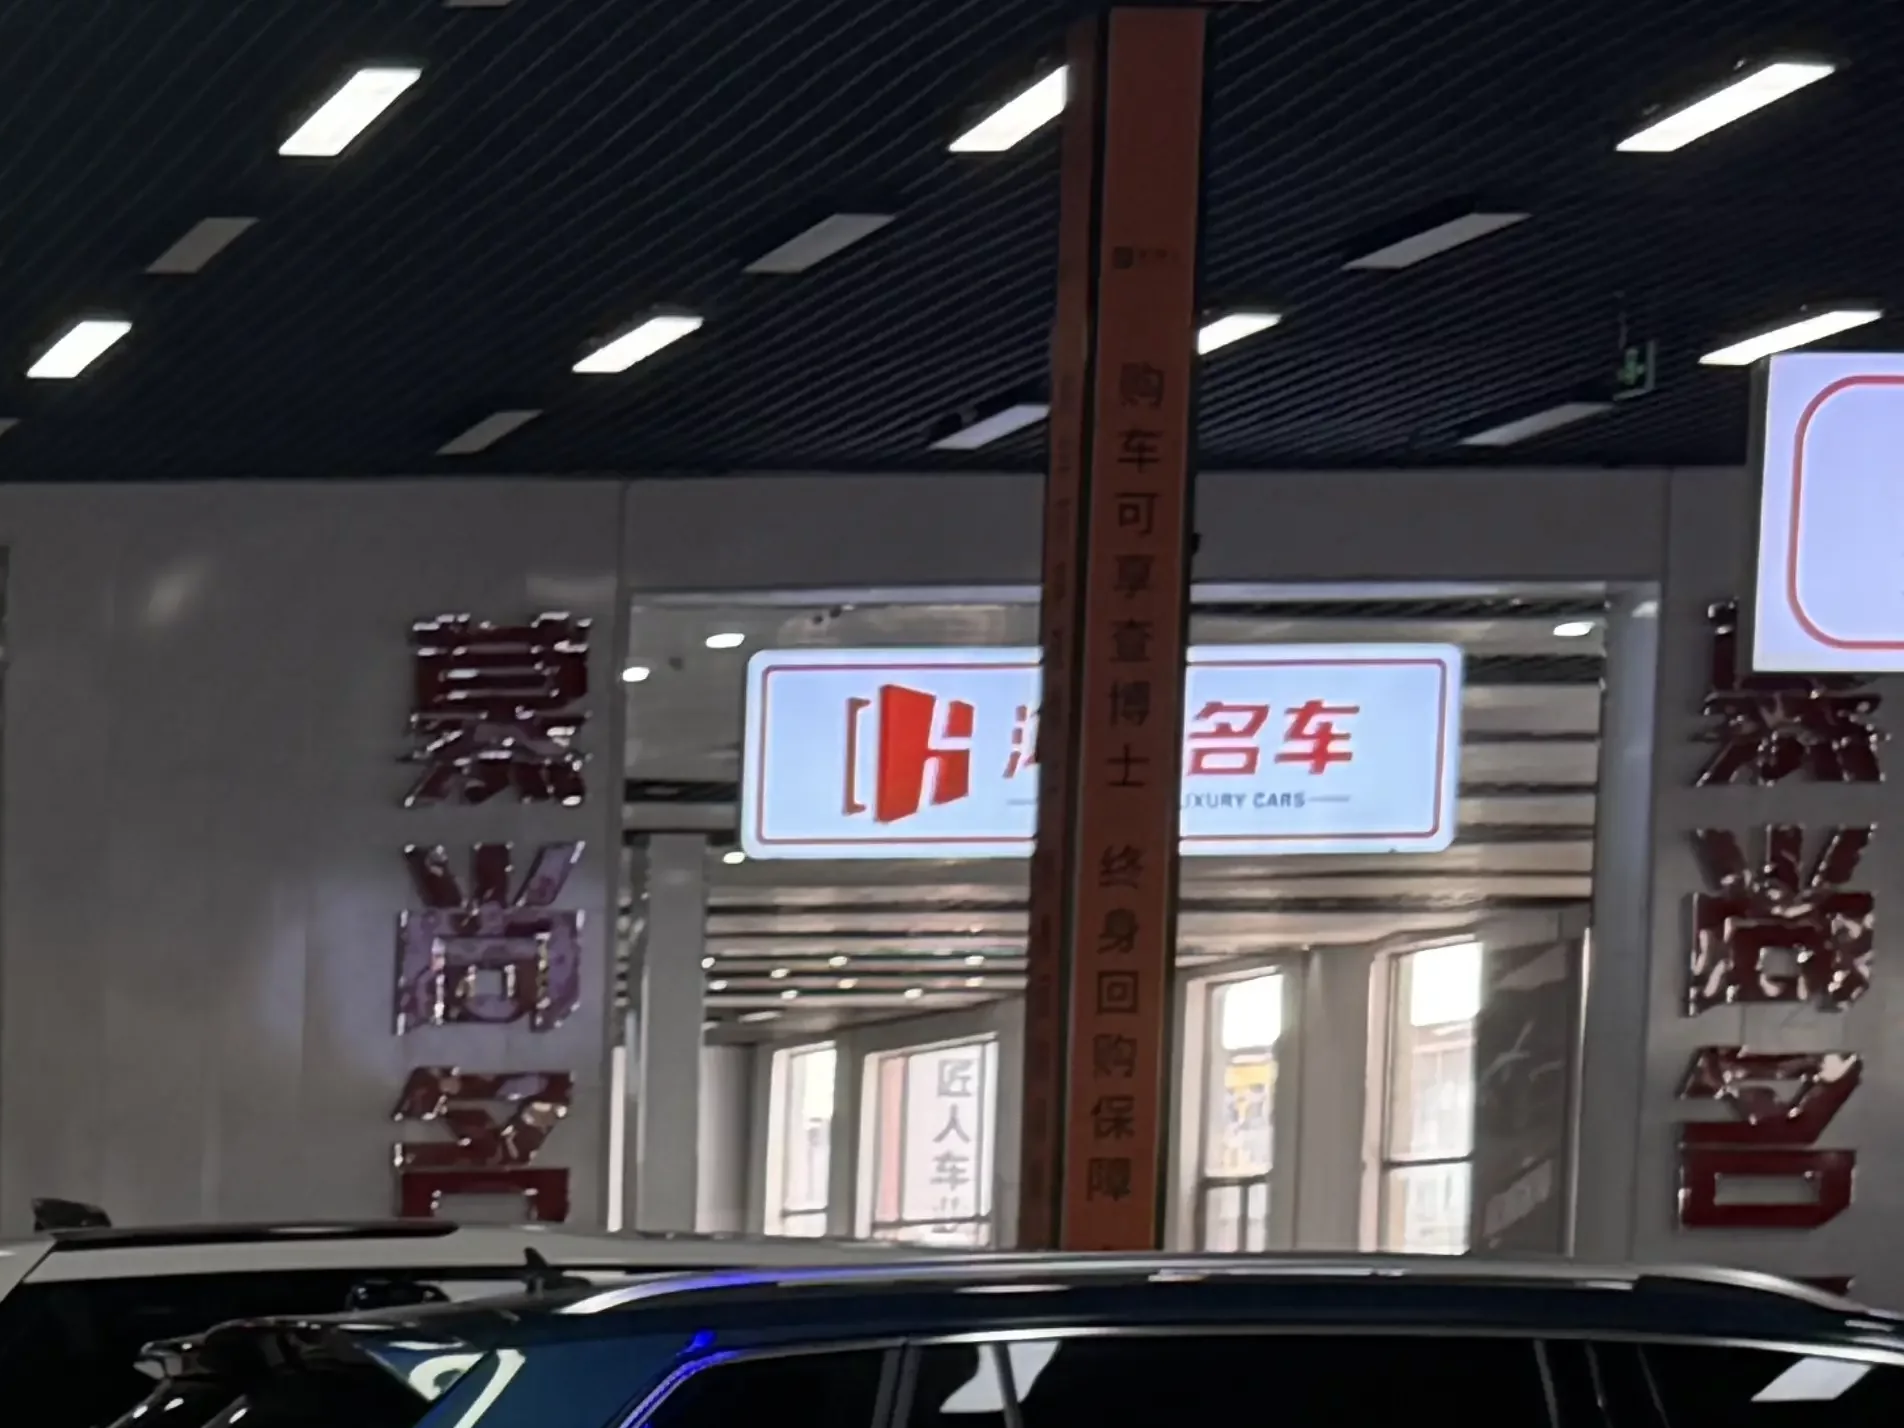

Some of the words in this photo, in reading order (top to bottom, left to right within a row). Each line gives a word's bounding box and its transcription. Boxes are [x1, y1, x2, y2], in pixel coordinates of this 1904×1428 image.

[1104, 362, 1165, 788] 购车可享查博士
[1253, 790, 1306, 809] CARS
[1085, 844, 1146, 1203] 终身回购保障
